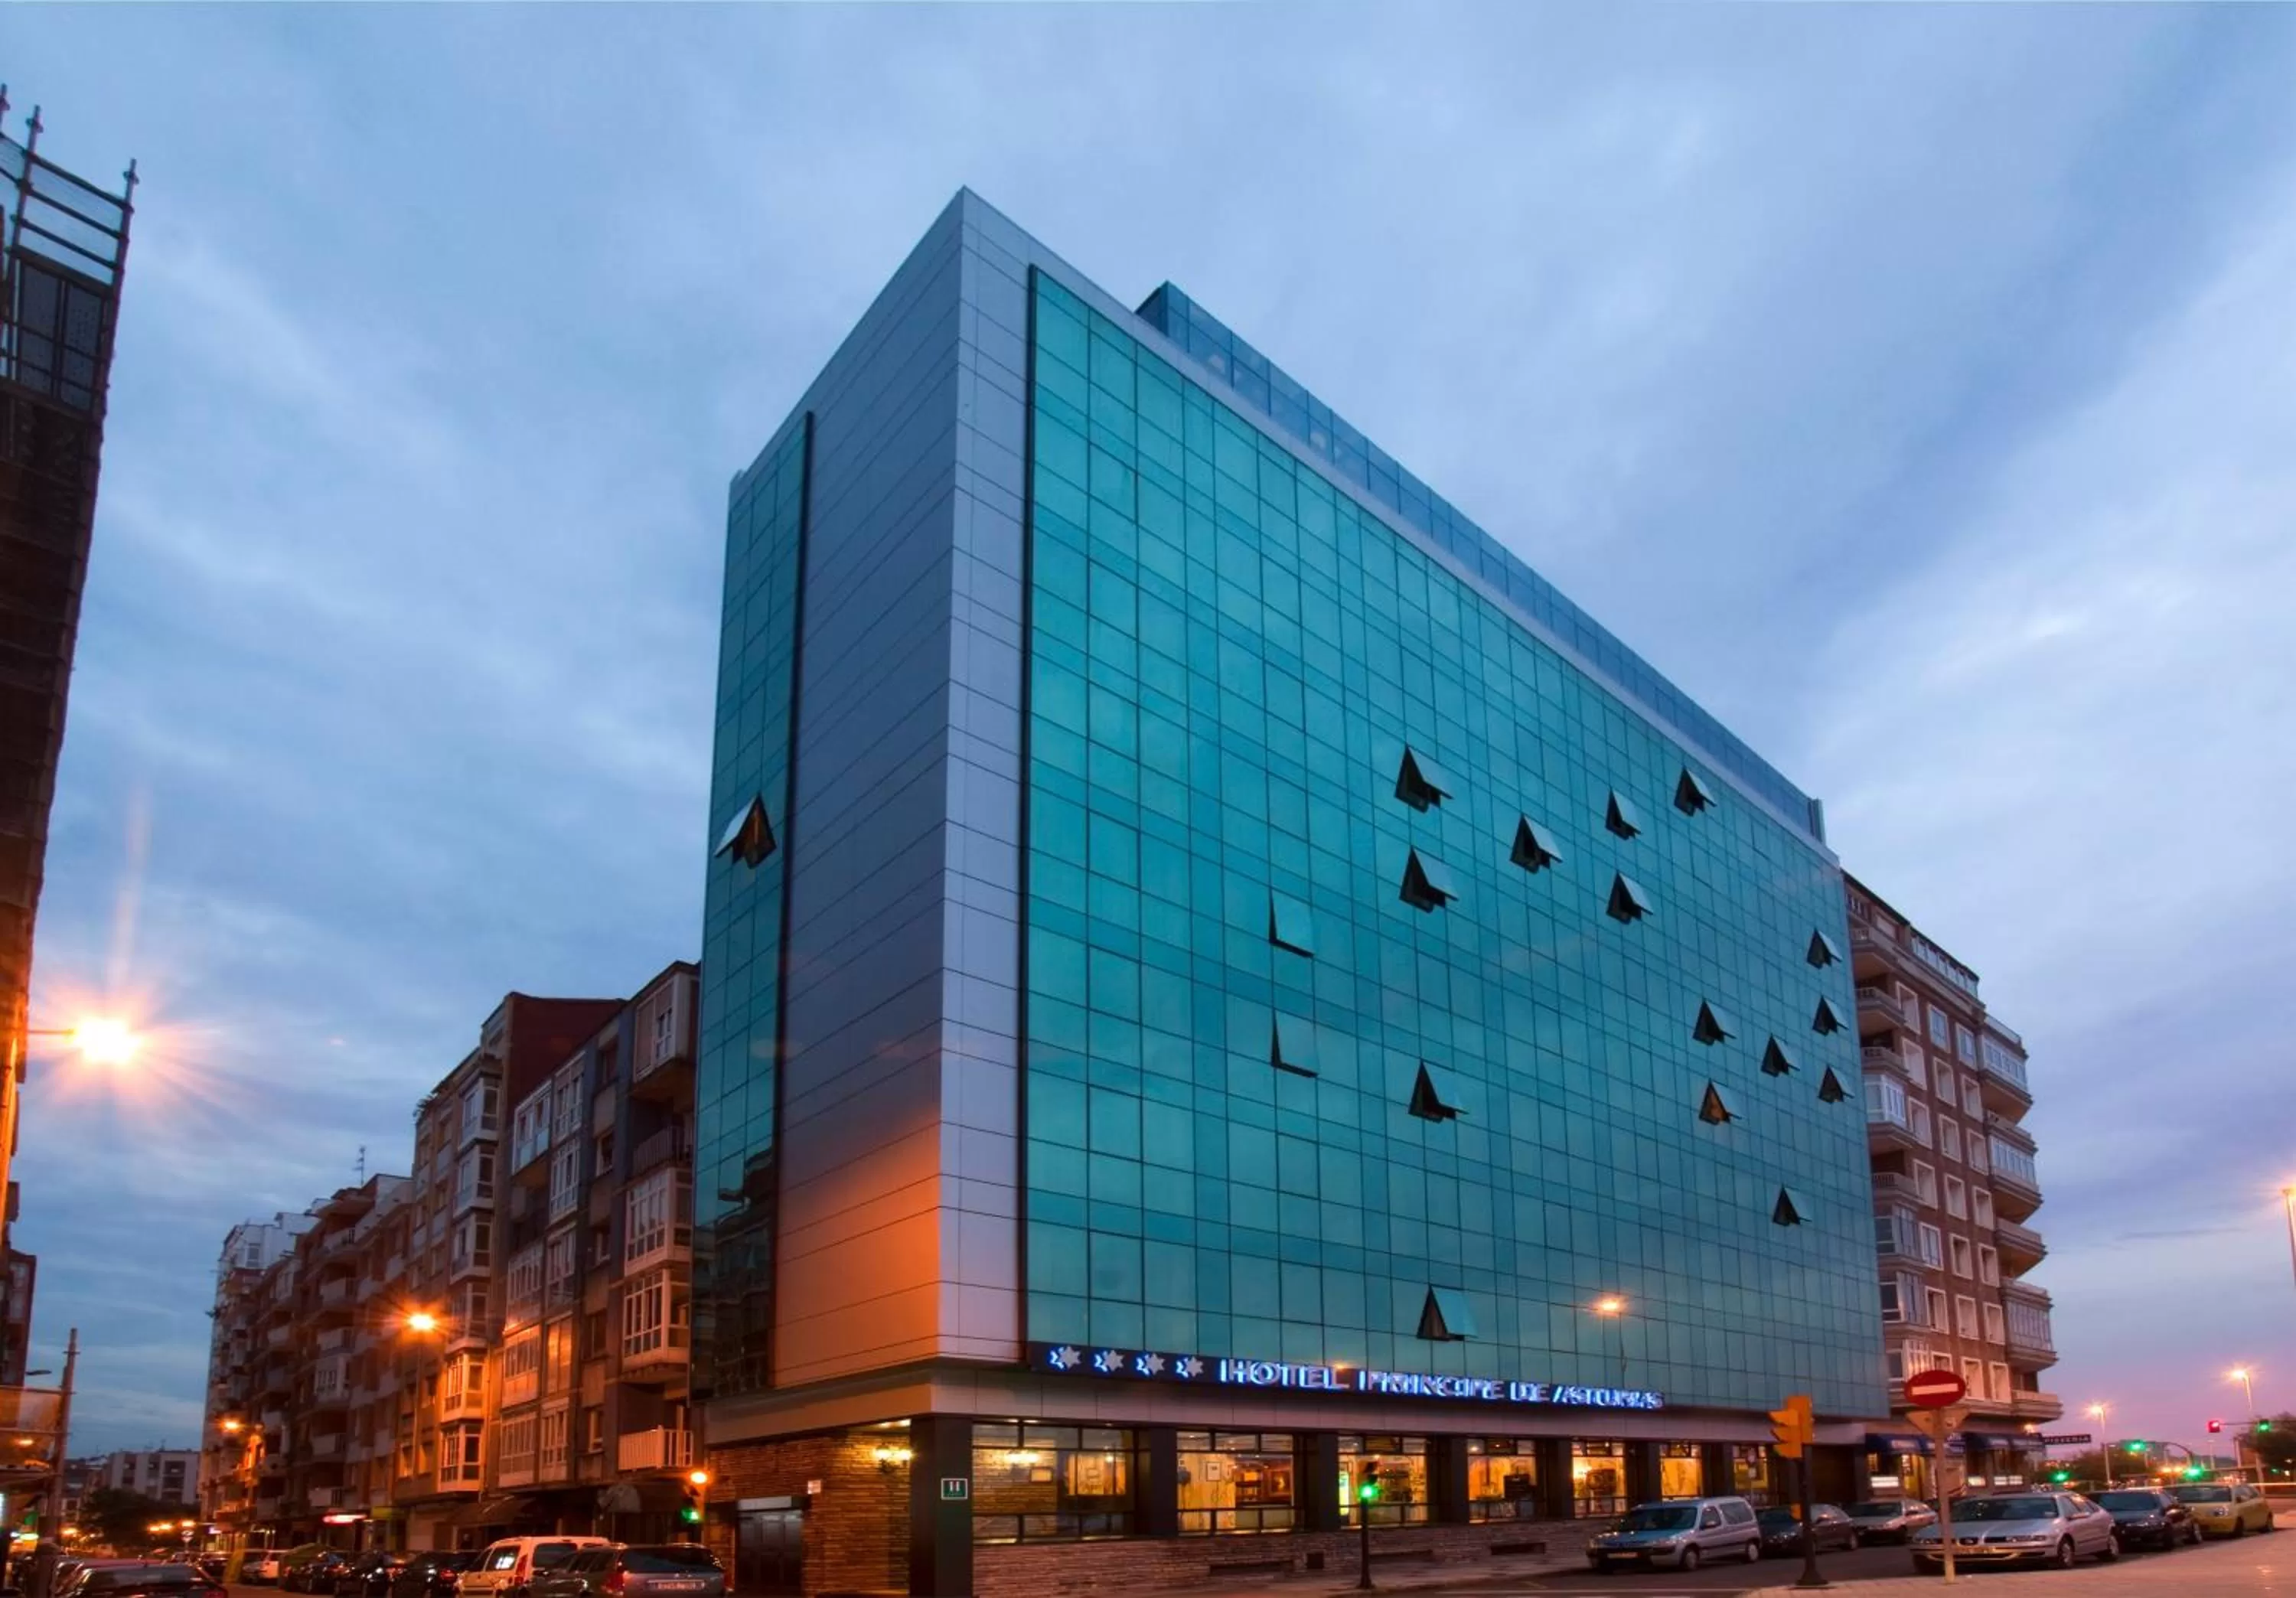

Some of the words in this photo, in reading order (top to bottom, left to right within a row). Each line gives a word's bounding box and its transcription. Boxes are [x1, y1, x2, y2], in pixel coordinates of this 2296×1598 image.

[1219, 1358, 1350, 1389] HOTEL
[1509, 1381, 1551, 1402] DE
[1551, 1385, 1665, 1409] ASTURIAS
